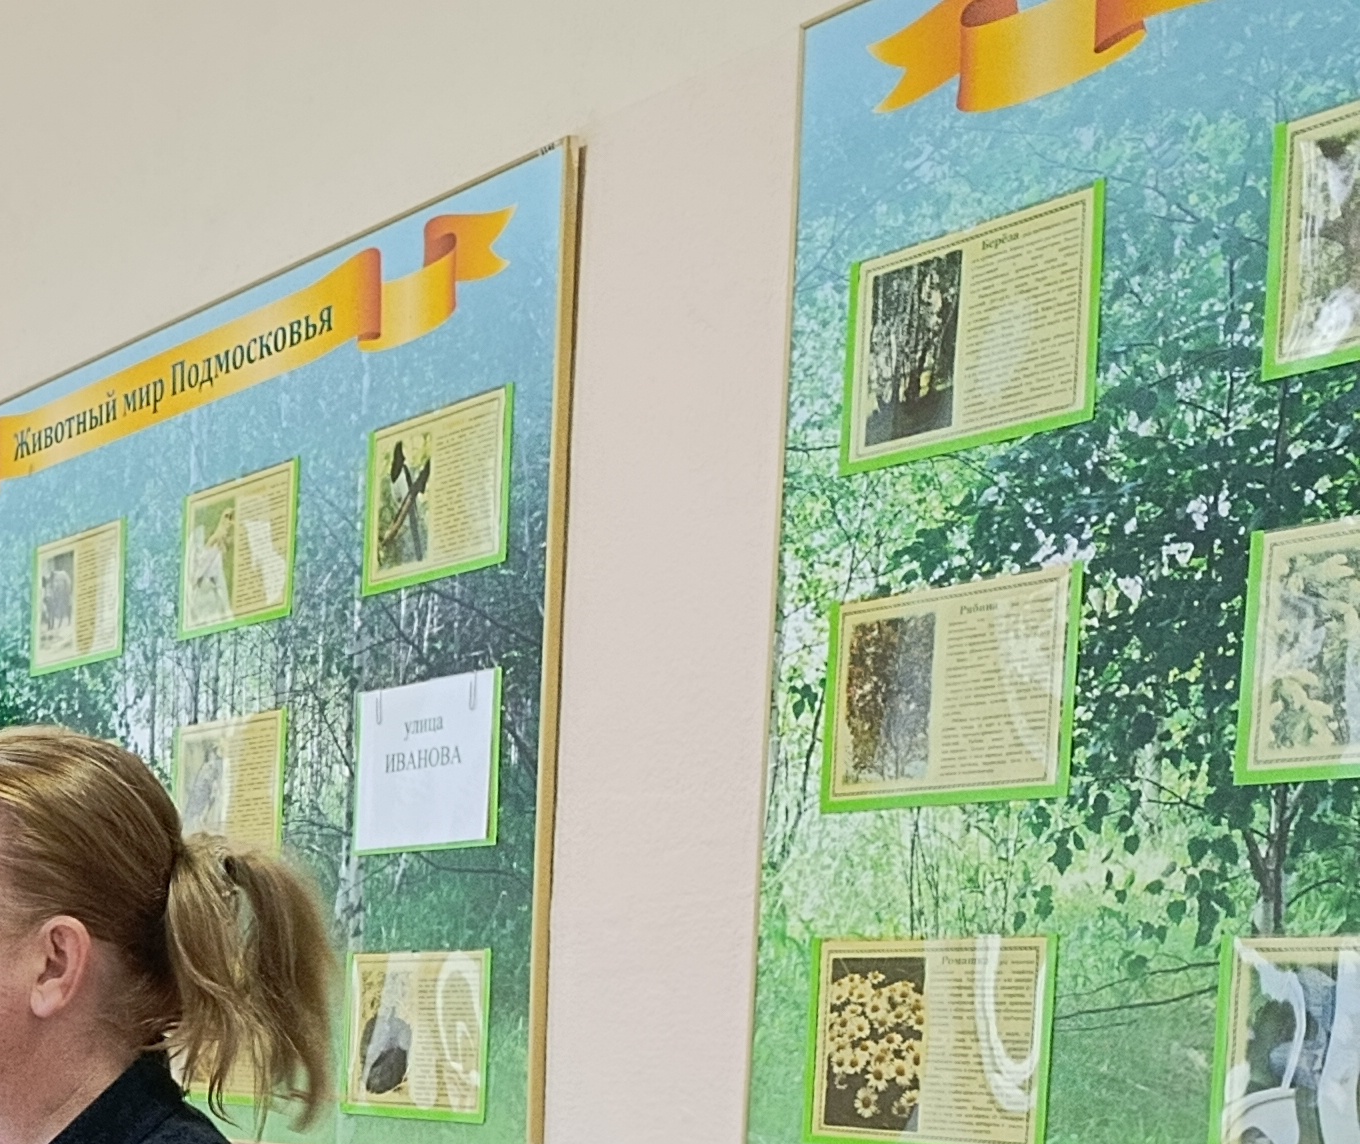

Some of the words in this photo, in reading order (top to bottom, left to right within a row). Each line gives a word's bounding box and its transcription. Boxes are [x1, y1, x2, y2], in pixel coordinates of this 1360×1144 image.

[13, 390, 117, 462] Животный
[122, 379, 165, 415] мир
[170, 305, 333, 397] Подмосковья
[403, 716, 443, 741] улица
[385, 745, 462, 773] ИВАНОВА
